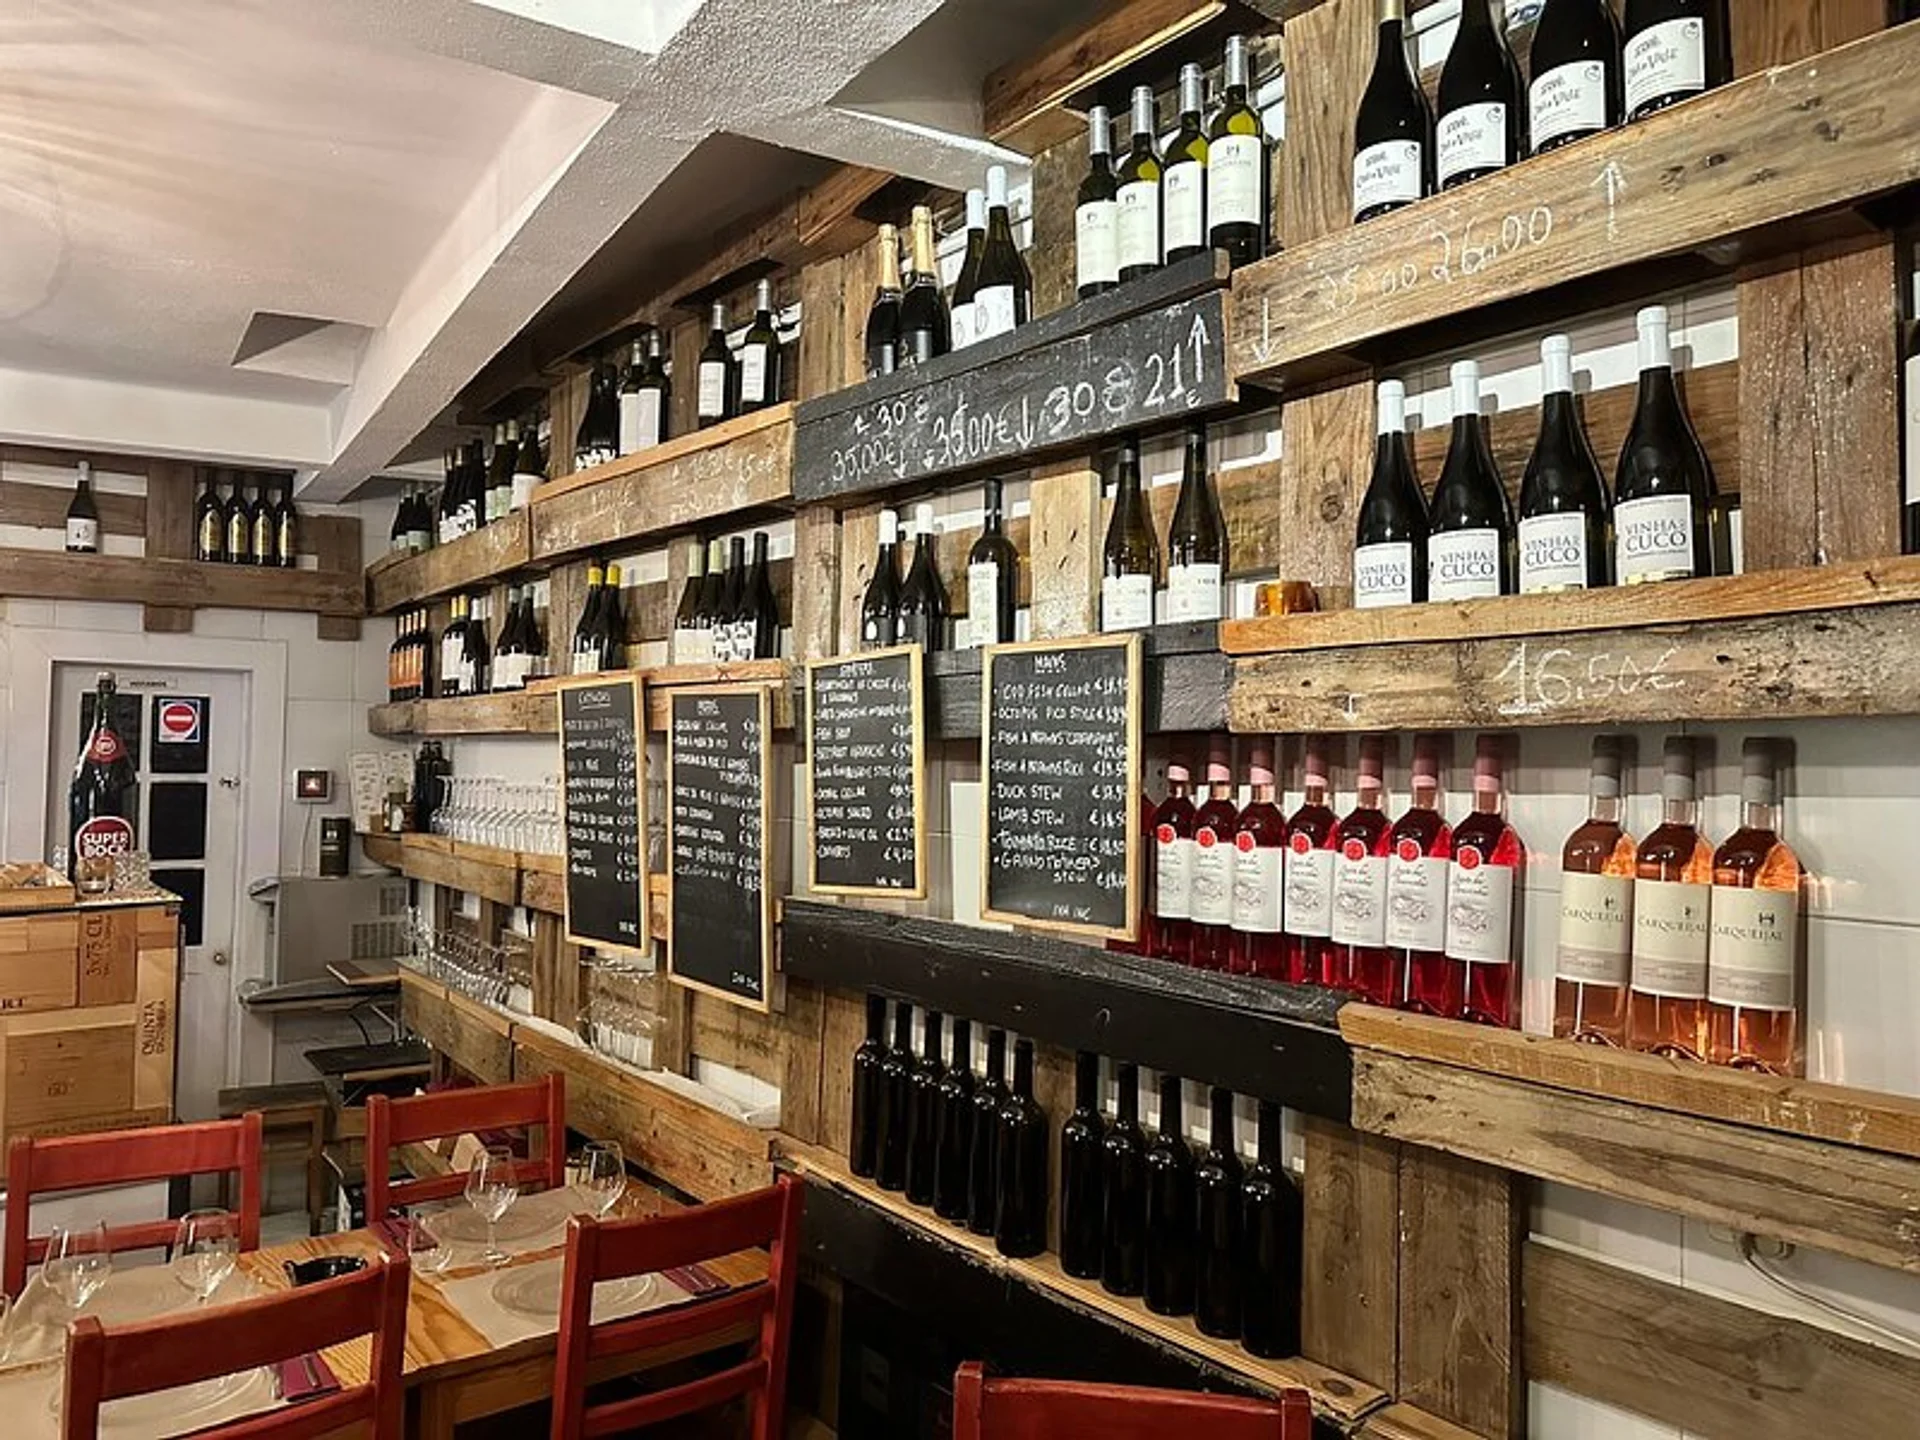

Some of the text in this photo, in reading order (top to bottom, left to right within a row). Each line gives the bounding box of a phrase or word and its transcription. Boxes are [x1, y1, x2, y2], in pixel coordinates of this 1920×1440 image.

[1626, 530, 1687, 552] CUCO
[1524, 546, 1580, 567] CUCO
[1440, 560, 1496, 577] CUCO
[1359, 573, 1406, 589] CUCO
[997, 783, 1063, 801] DUCK STEW
[1031, 808, 1065, 825] STEW
[82, 831, 128, 846] SUPER
